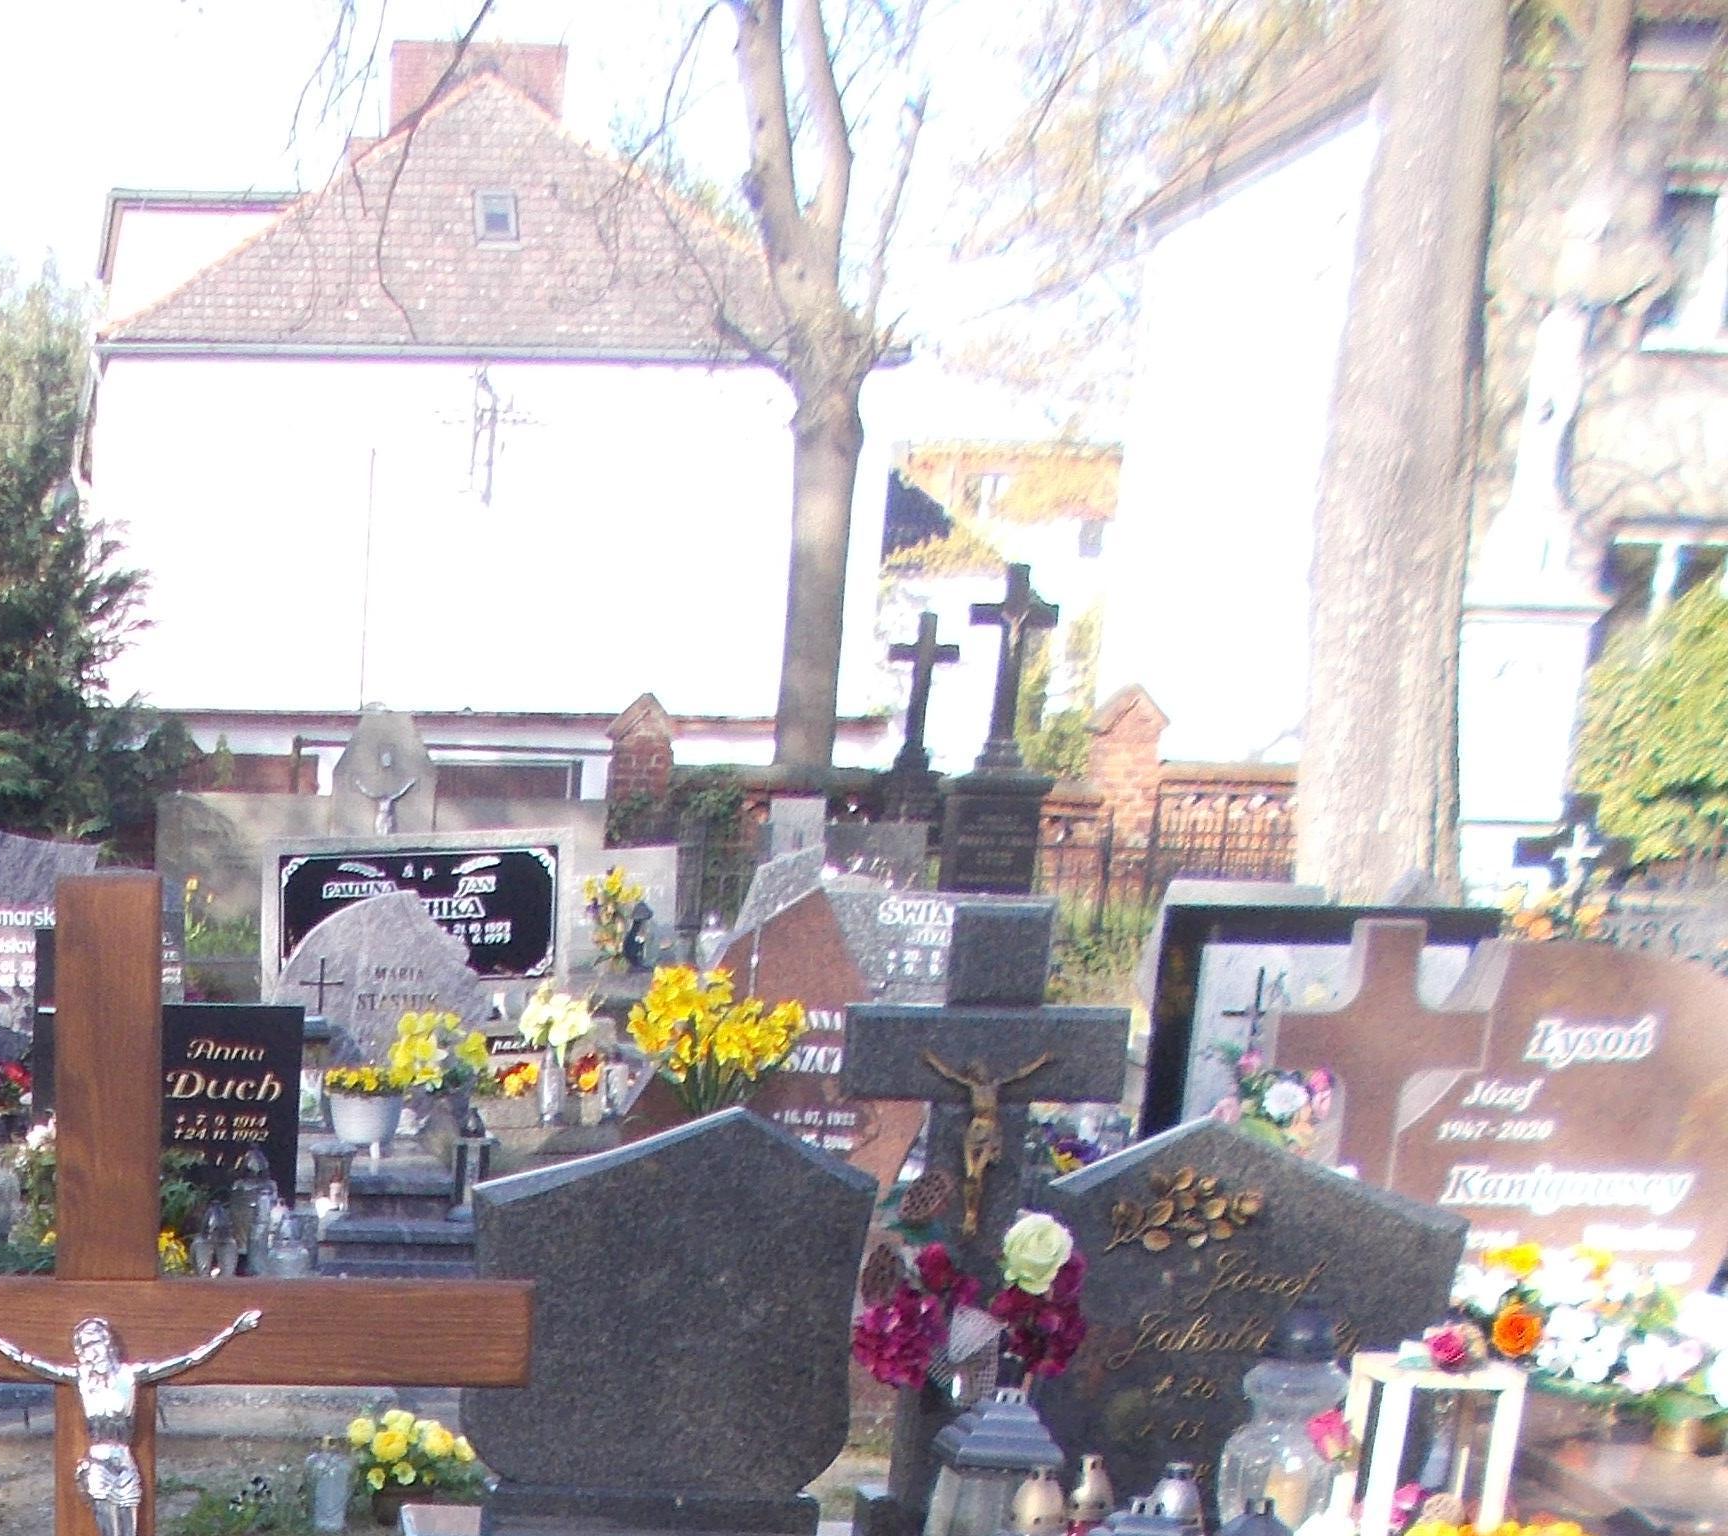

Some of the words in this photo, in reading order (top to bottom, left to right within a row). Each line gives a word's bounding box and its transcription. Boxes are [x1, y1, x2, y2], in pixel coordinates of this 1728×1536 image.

[454, 875, 497, 898] JAN
[186, 1038, 265, 1062] Anna
[1525, 1014, 1658, 1068] Łysoń
[165, 1070, 283, 1102] Duch
[1462, 1078, 1544, 1111] Józef
